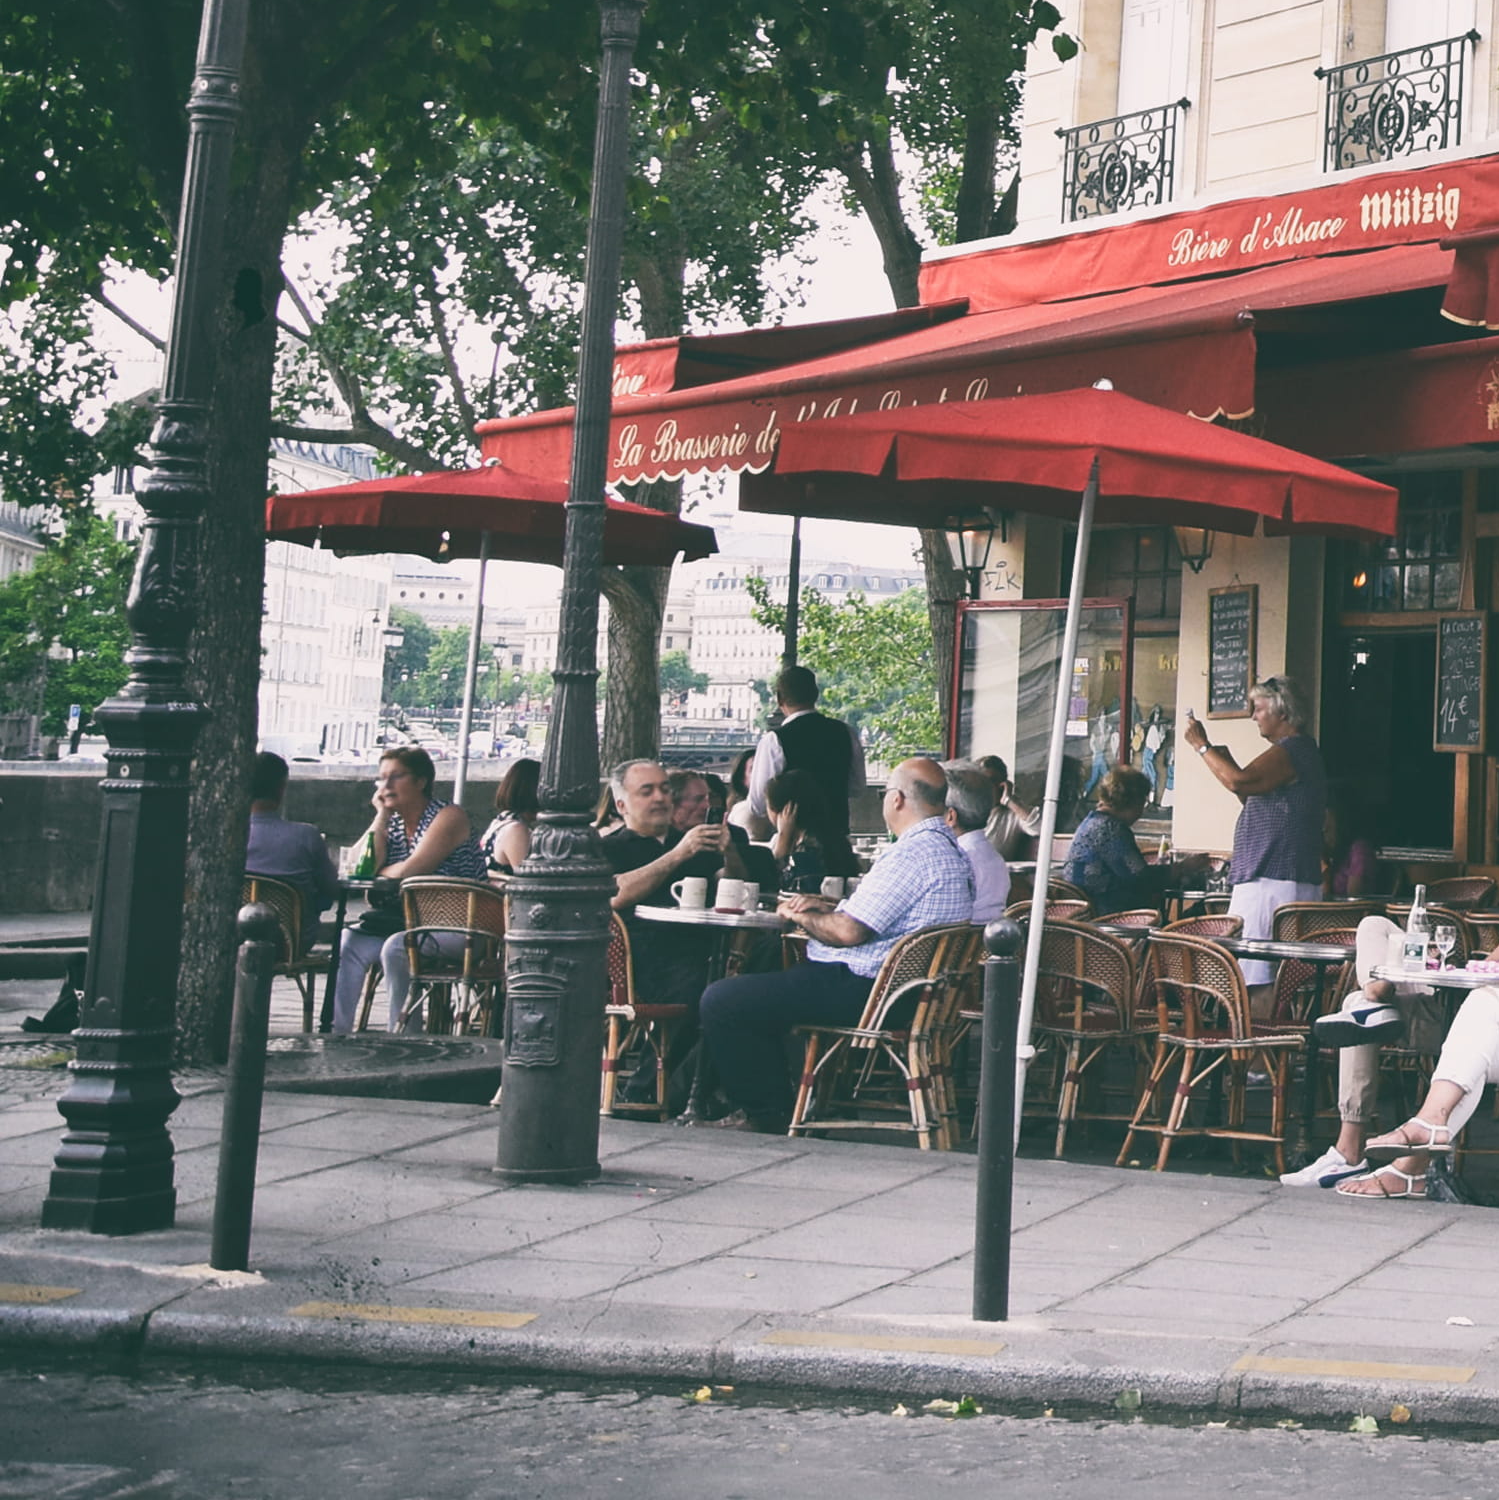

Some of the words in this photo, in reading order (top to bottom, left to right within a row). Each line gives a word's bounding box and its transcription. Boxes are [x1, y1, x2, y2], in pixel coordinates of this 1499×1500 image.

[1168, 227, 1233, 267] Bière
[1240, 207, 1349, 255] d'Alsace
[612, 424, 647, 468] La
[650, 419, 752, 464] Brasserie
[754, 410, 782, 455] de
